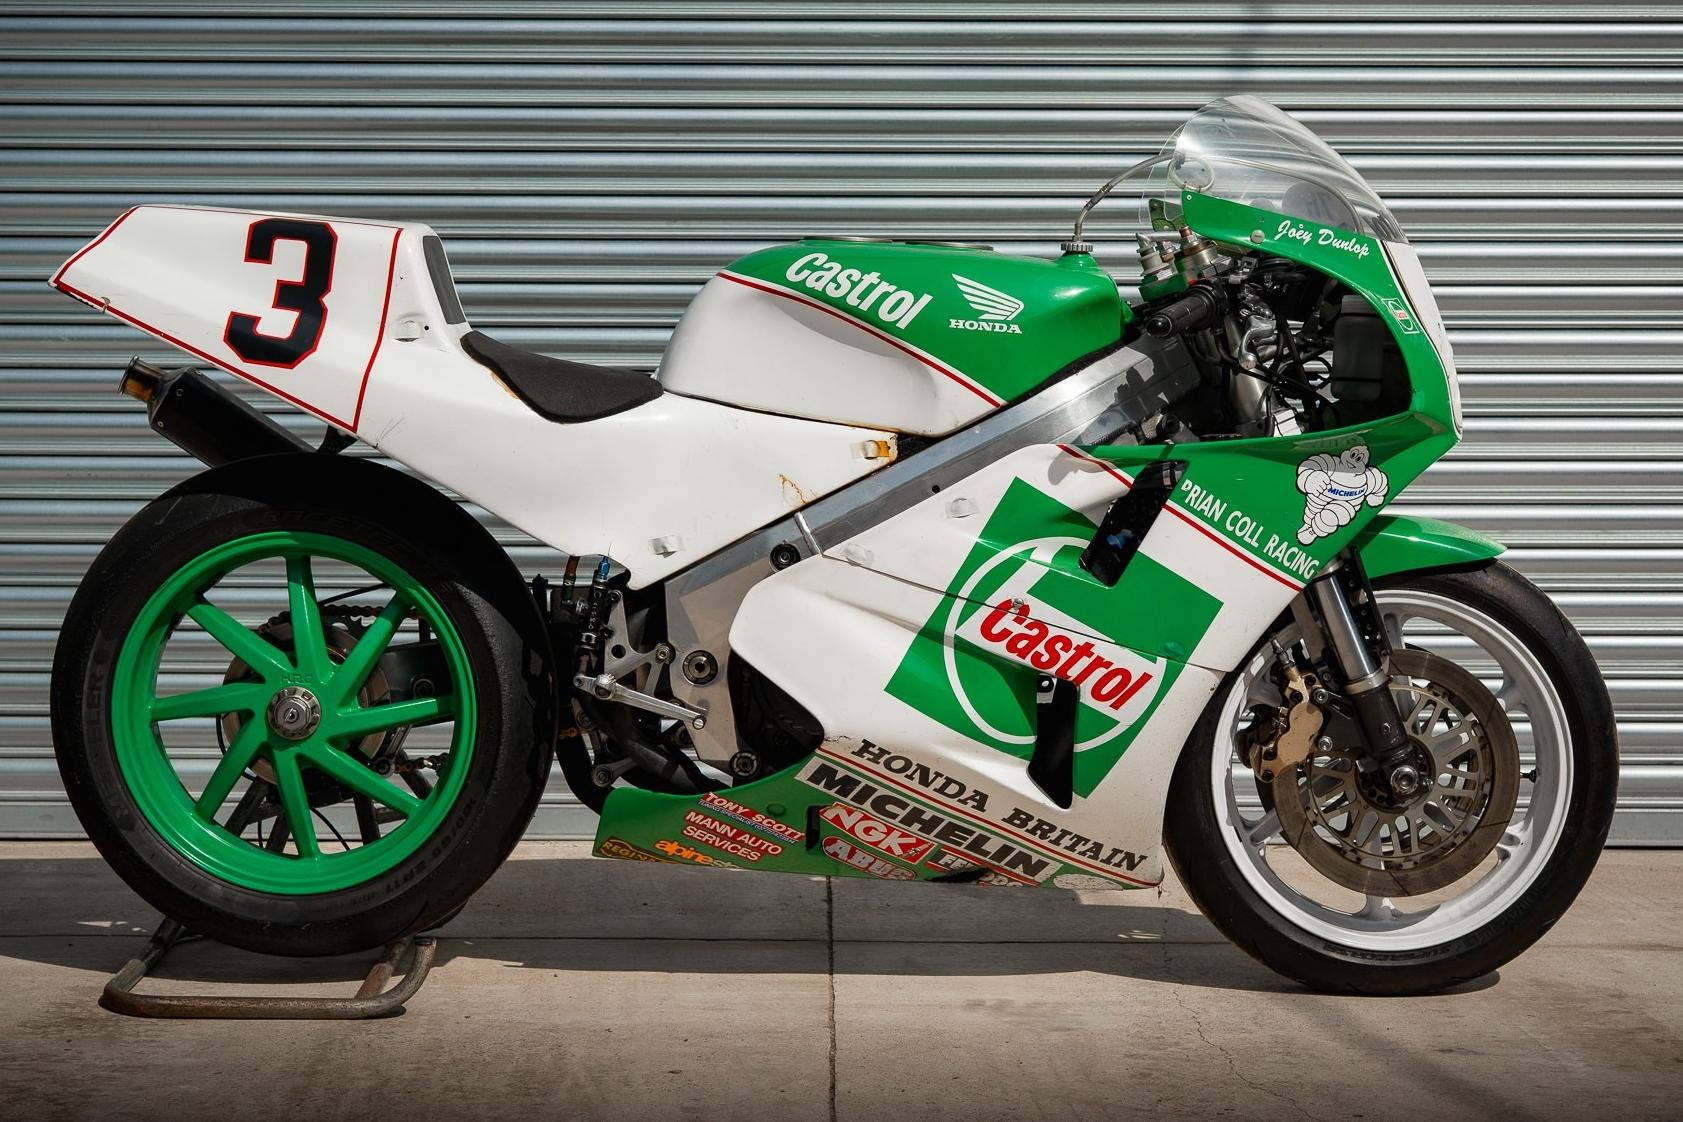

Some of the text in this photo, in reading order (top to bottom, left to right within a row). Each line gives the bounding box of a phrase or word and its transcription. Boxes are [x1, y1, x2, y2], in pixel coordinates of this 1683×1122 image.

[1274, 220, 1370, 259] Joey Dunlop
[223, 217, 338, 370] 3
[786, 253, 933, 329] Castrol
[949, 319, 1022, 334] HONDA
[1327, 487, 1365, 497] MICHELIN
[1225, 510, 1264, 548] COLL
[1263, 534, 1320, 580] RACING
[979, 598, 1153, 711] Castrol
[705, 792, 750, 814] TONY
[752, 813, 805, 840] SCOTT
[807, 763, 1050, 878] MICHELIN
[851, 738, 1148, 872] HONDA BRITAIN
[683, 826, 761, 861] SERVICES
[685, 811, 738, 838] MANN
[741, 833, 782, 855] AUTO
[824, 807, 917, 856] NGK
